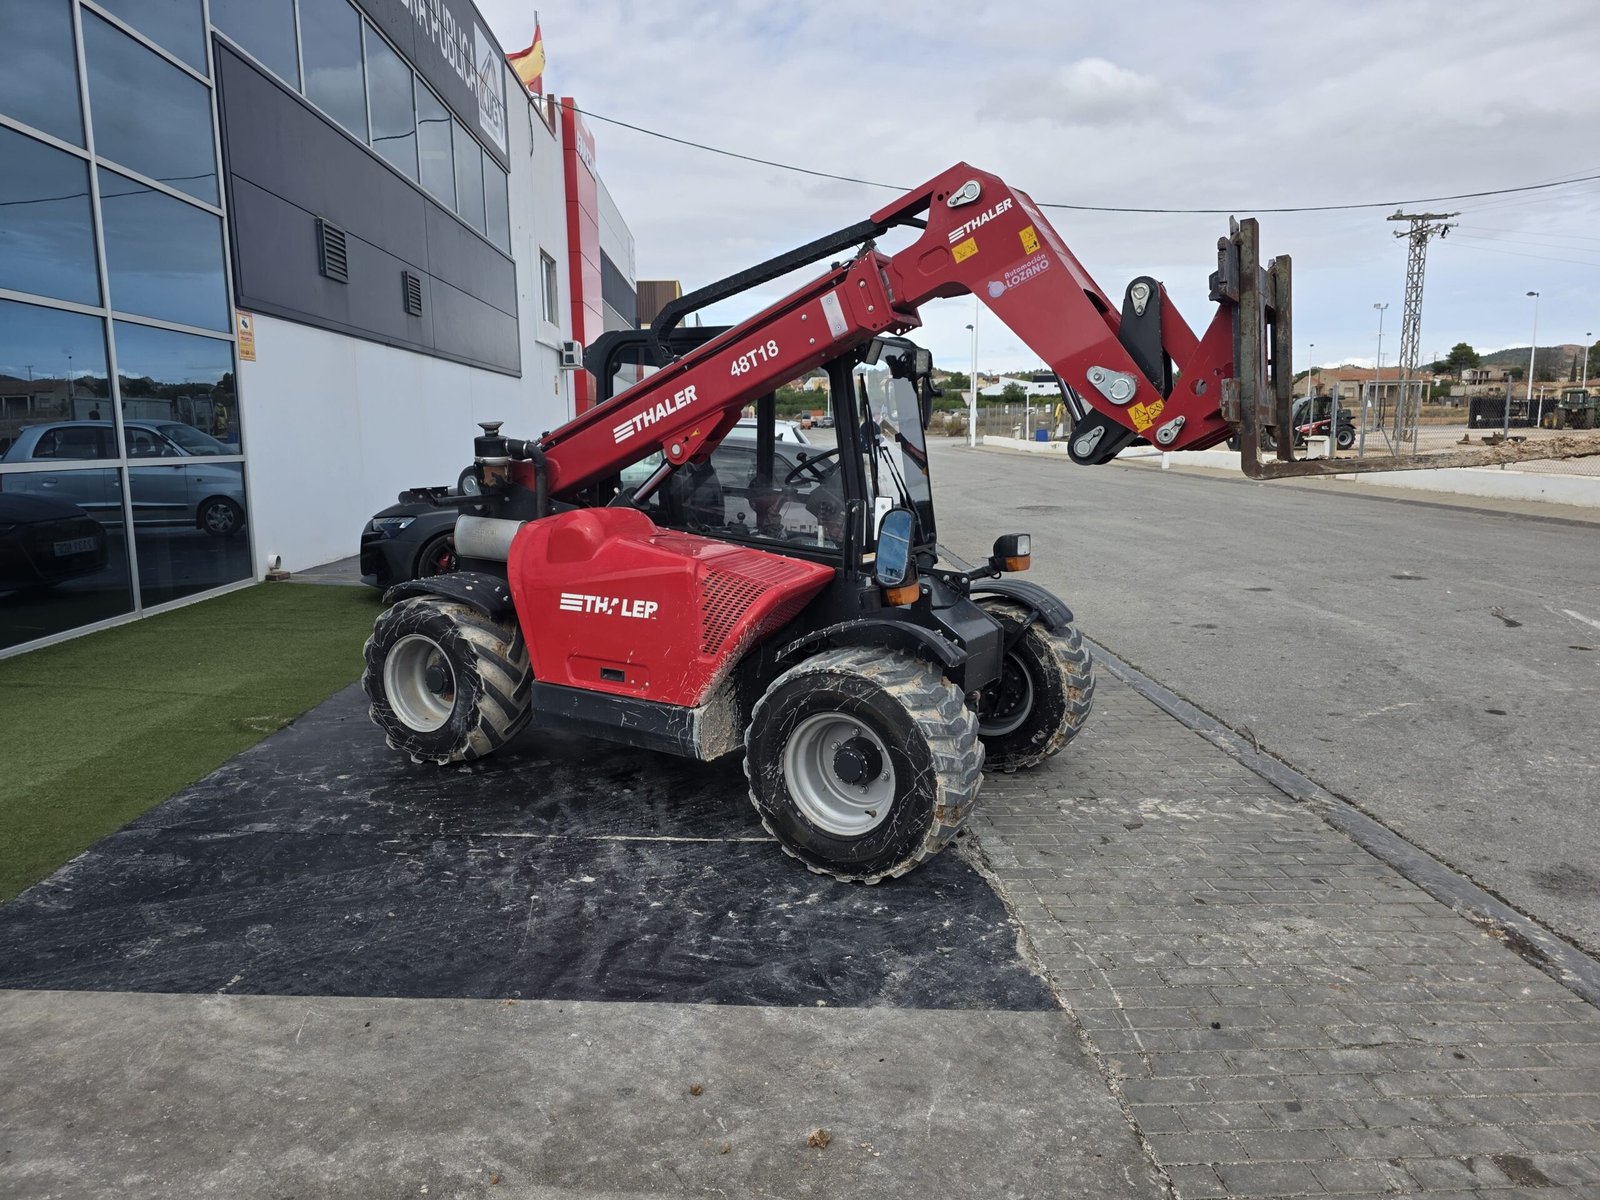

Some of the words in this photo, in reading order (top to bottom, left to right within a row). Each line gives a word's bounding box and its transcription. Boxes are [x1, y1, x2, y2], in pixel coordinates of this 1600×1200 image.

[431, 0, 478, 98] PUBLICA
[963, 198, 1013, 234] THALER
[1004, 253, 1046, 279] Automoción
[1006, 260, 1049, 288] LOZANO
[731, 340, 779, 377] 48T18
[632, 385, 698, 433] THALER
